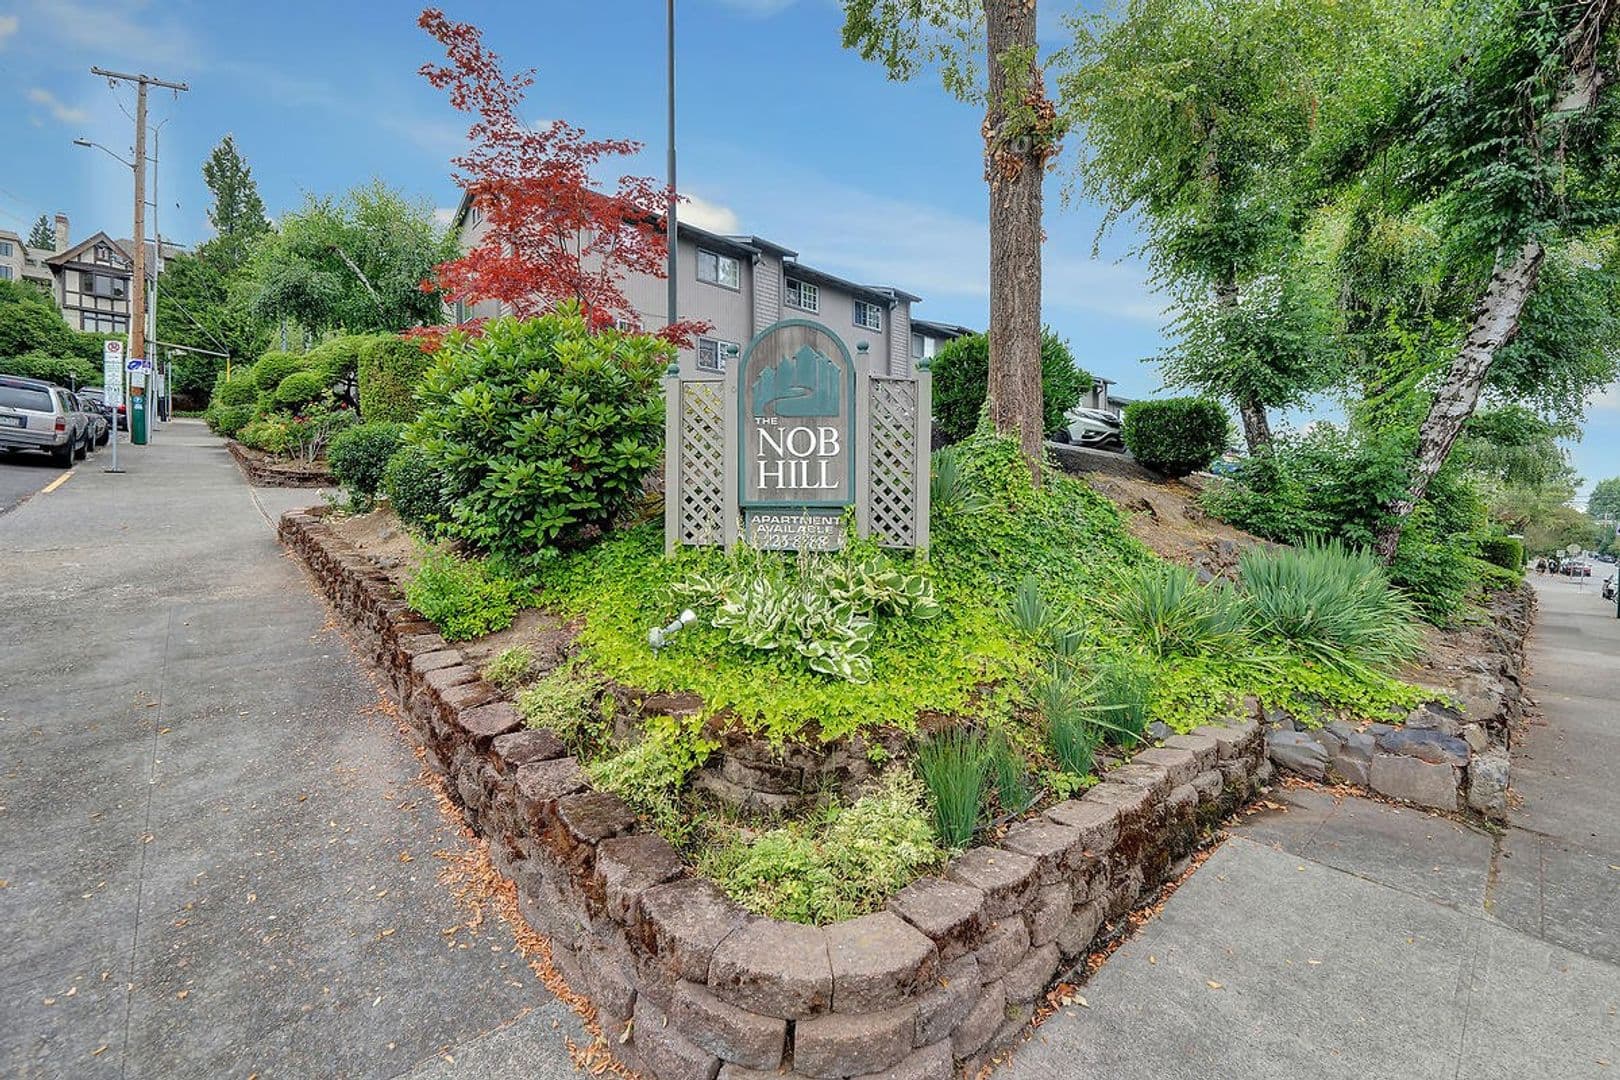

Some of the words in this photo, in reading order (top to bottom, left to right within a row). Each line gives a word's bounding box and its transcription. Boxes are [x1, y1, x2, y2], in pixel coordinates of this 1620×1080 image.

[755, 417, 779, 425] THE
[757, 426, 840, 457] NOB
[757, 460, 840, 489] HILL
[751, 515, 840, 525] APARTMENT
